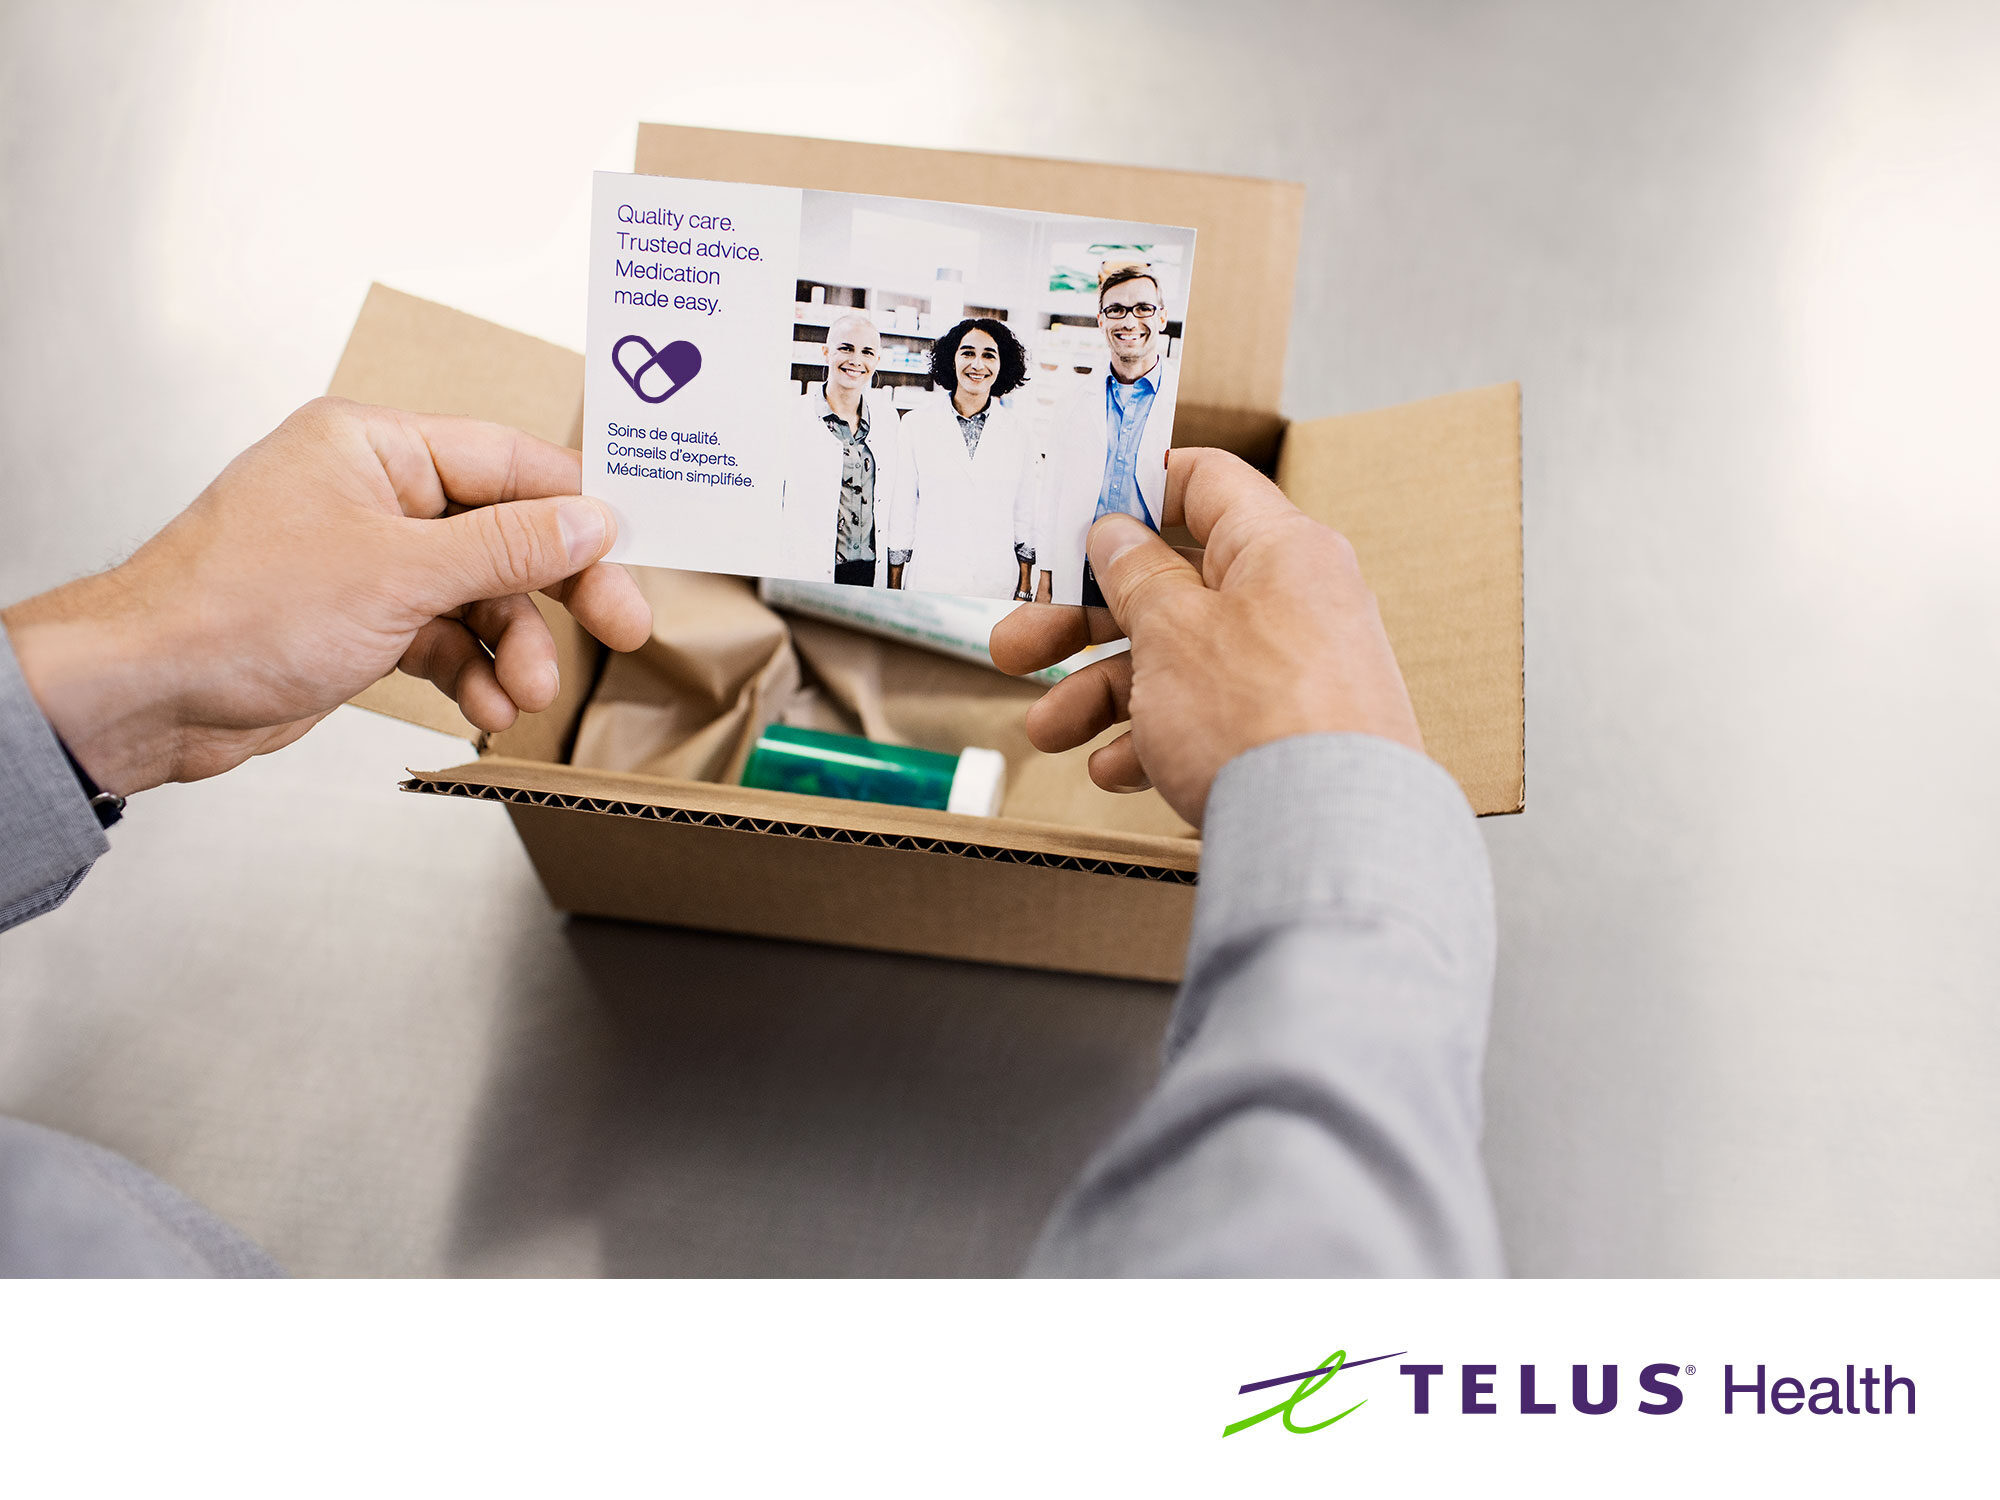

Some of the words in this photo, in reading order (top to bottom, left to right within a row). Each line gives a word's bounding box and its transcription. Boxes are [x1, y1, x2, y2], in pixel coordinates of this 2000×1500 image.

[617, 204, 684, 231] Quality
[689, 214, 736, 232] care.
[616, 231, 691, 255] Trusted
[696, 240, 763, 261] advice.
[615, 259, 720, 285] Medication
[614, 289, 668, 308] made
[674, 295, 722, 315] easy.
[607, 422, 646, 439] Soins
[649, 427, 667, 441] de
[671, 431, 721, 446] qualité.
[607, 442, 667, 460] Conseils
[607, 461, 683, 481] Médication
[686, 470, 755, 488] simplifiée.
